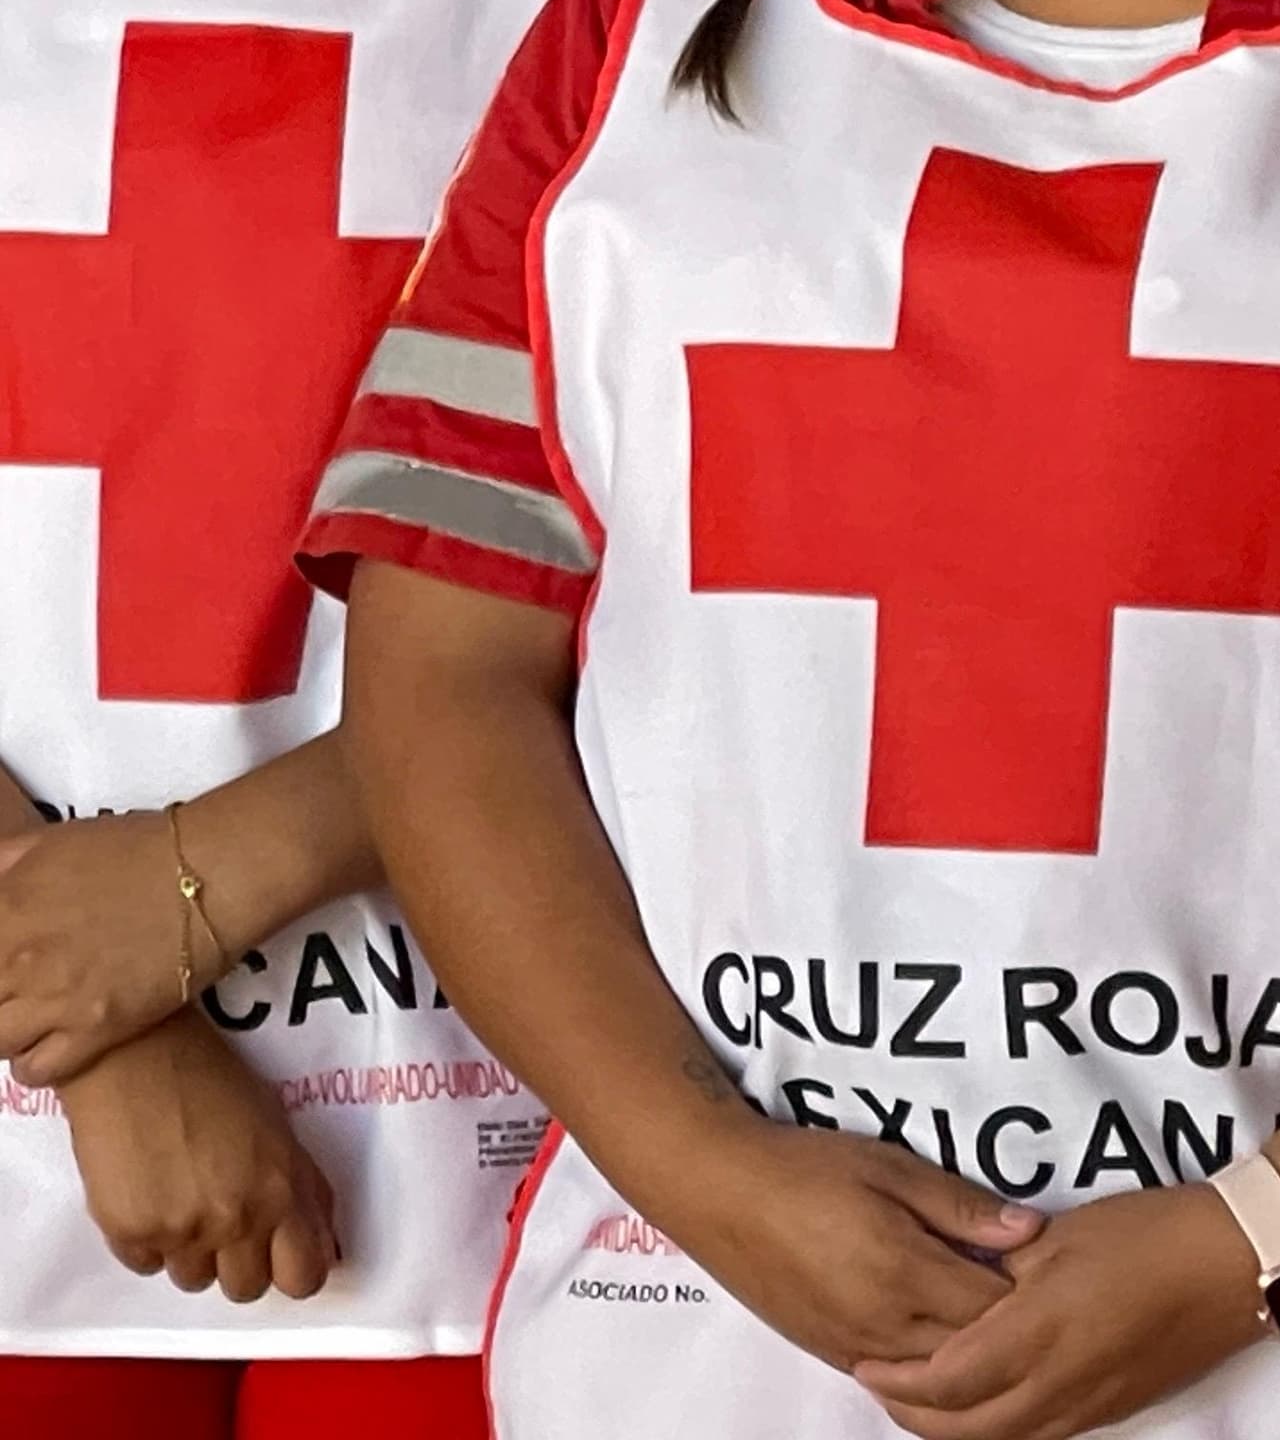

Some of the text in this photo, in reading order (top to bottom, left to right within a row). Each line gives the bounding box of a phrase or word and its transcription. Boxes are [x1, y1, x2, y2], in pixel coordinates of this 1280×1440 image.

[703, 952, 966, 1059] CRUZ
[568, 1279, 710, 1303] ASOCIADO No.
